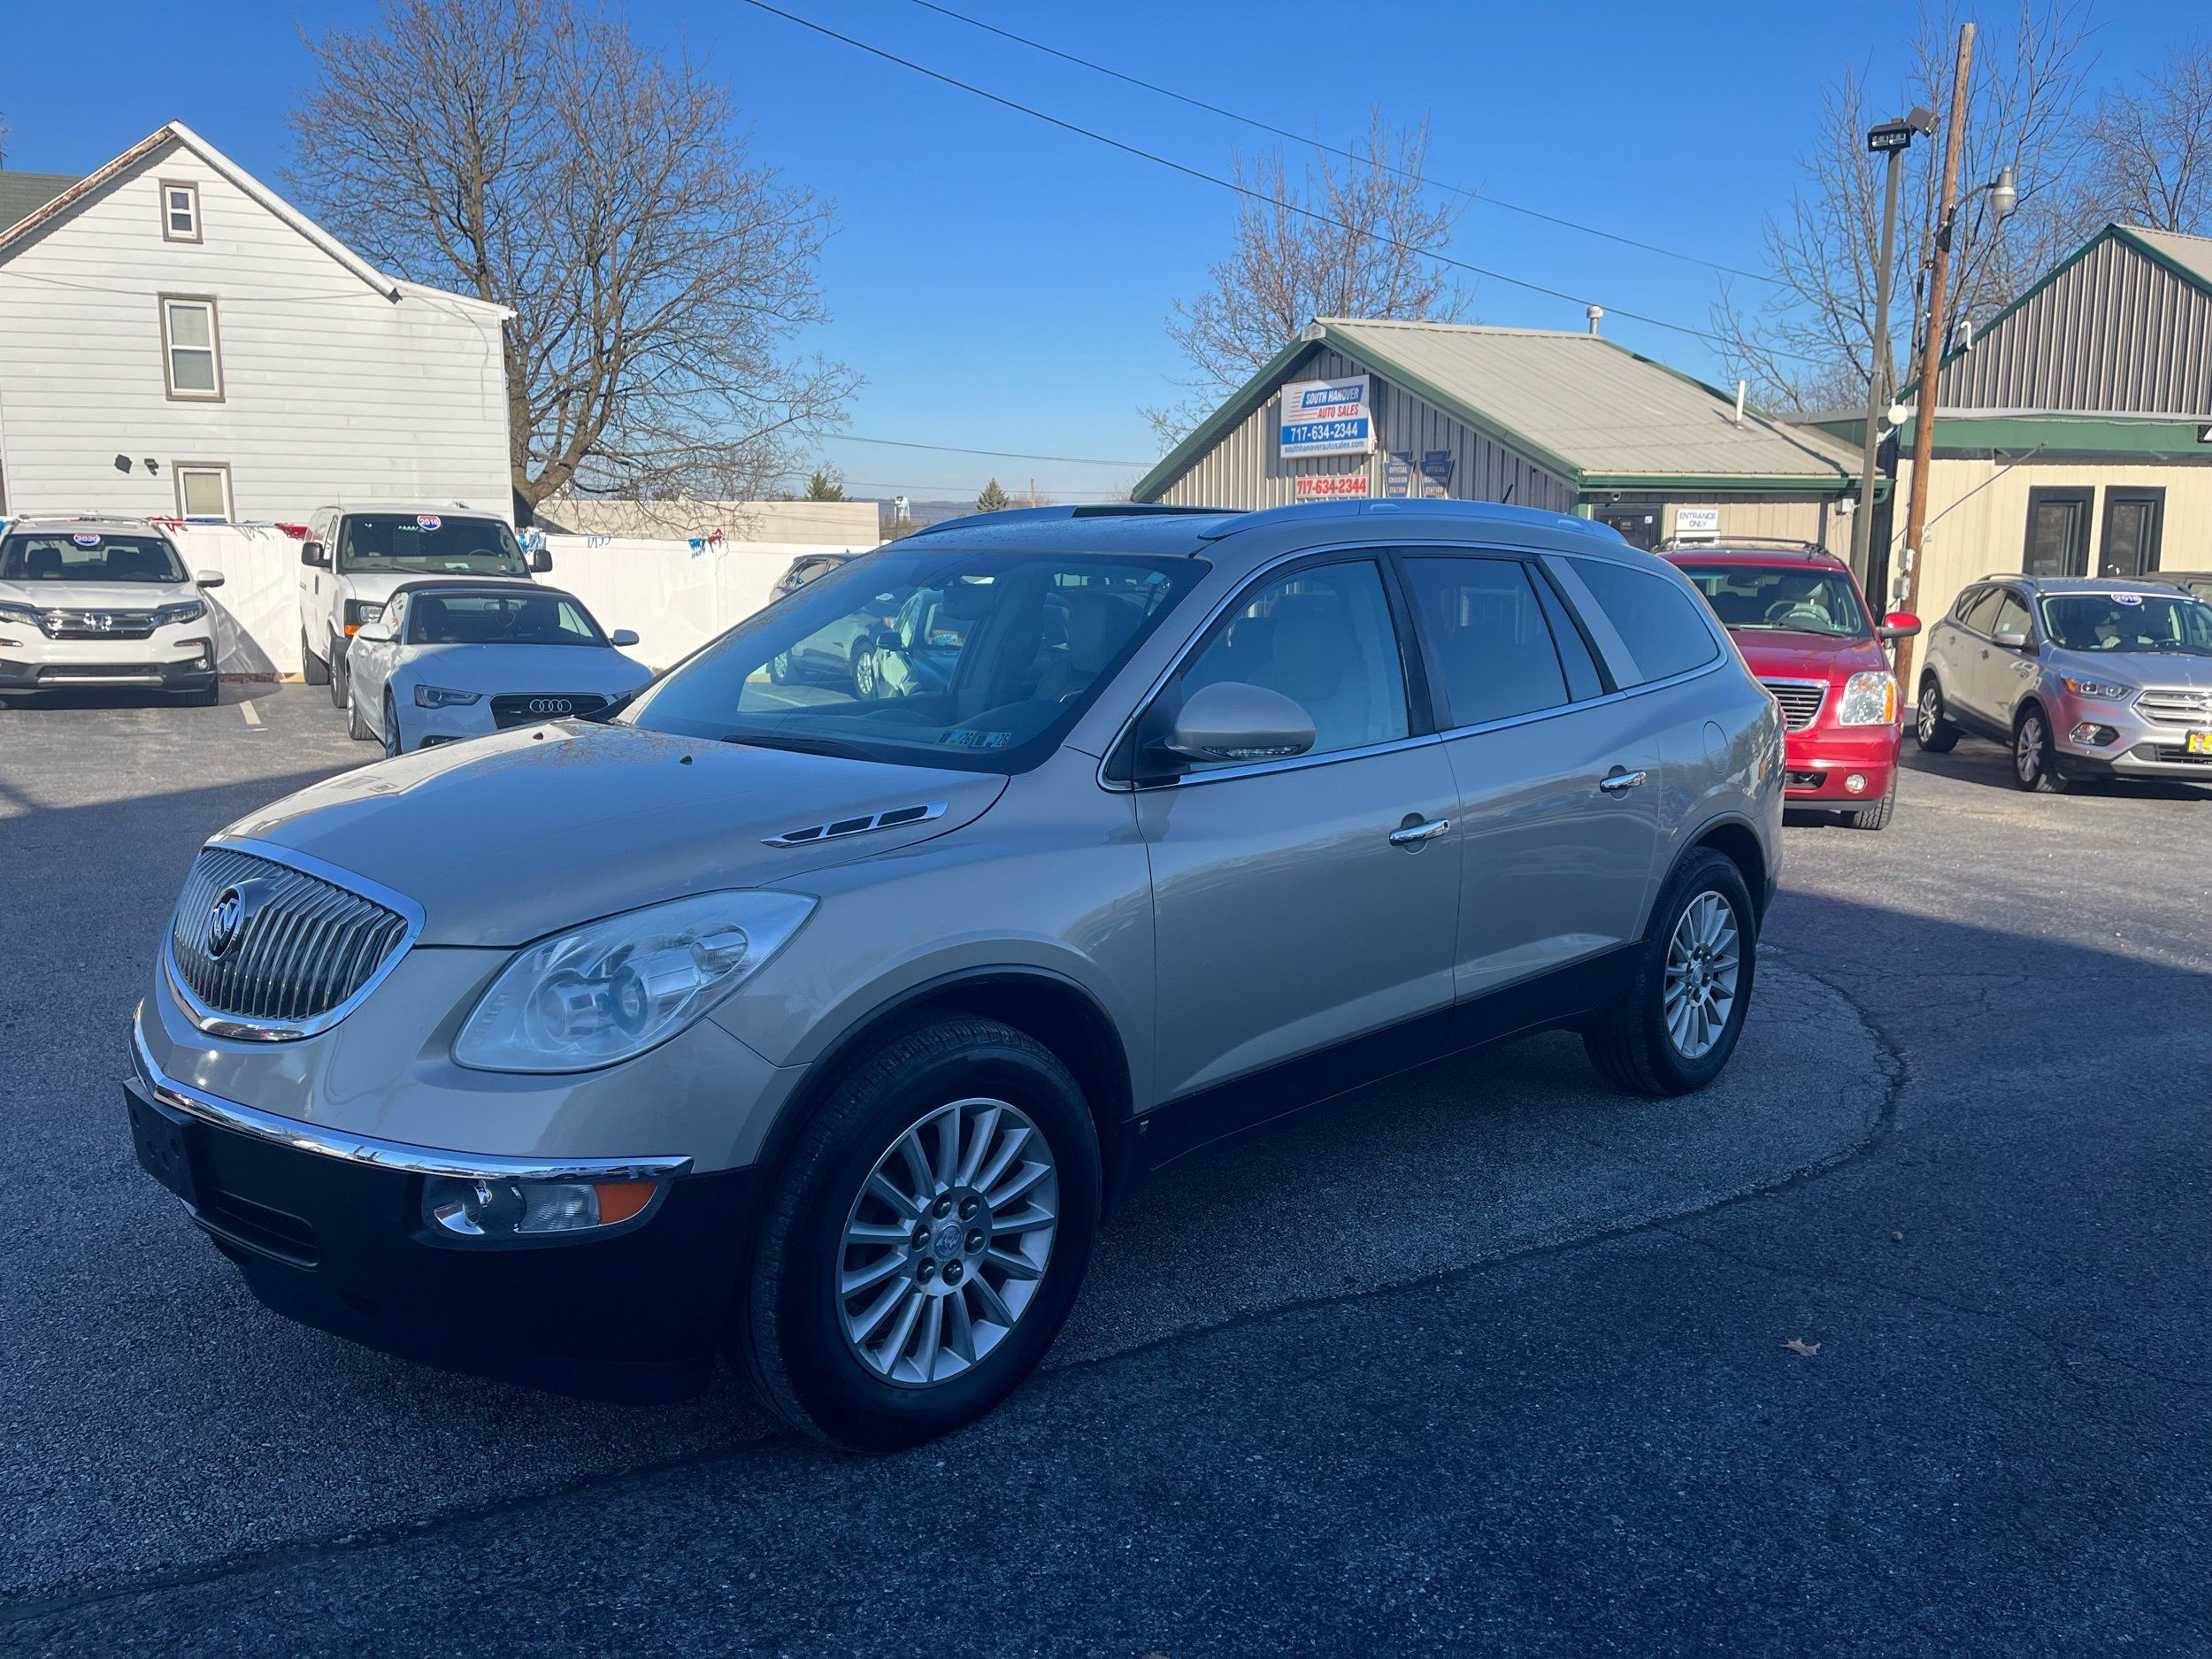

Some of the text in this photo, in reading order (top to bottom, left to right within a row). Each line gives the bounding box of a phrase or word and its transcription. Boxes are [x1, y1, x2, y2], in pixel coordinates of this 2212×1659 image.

[1306, 388, 1359, 405] SOUTH HANOVER
[1317, 403, 1359, 419] AUTO SALES
[1291, 421, 1358, 442] 717-634-2344
[1285, 441, 1364, 453] southhanoverautosales.com
[1296, 478, 1366, 495] 717-634-2344
